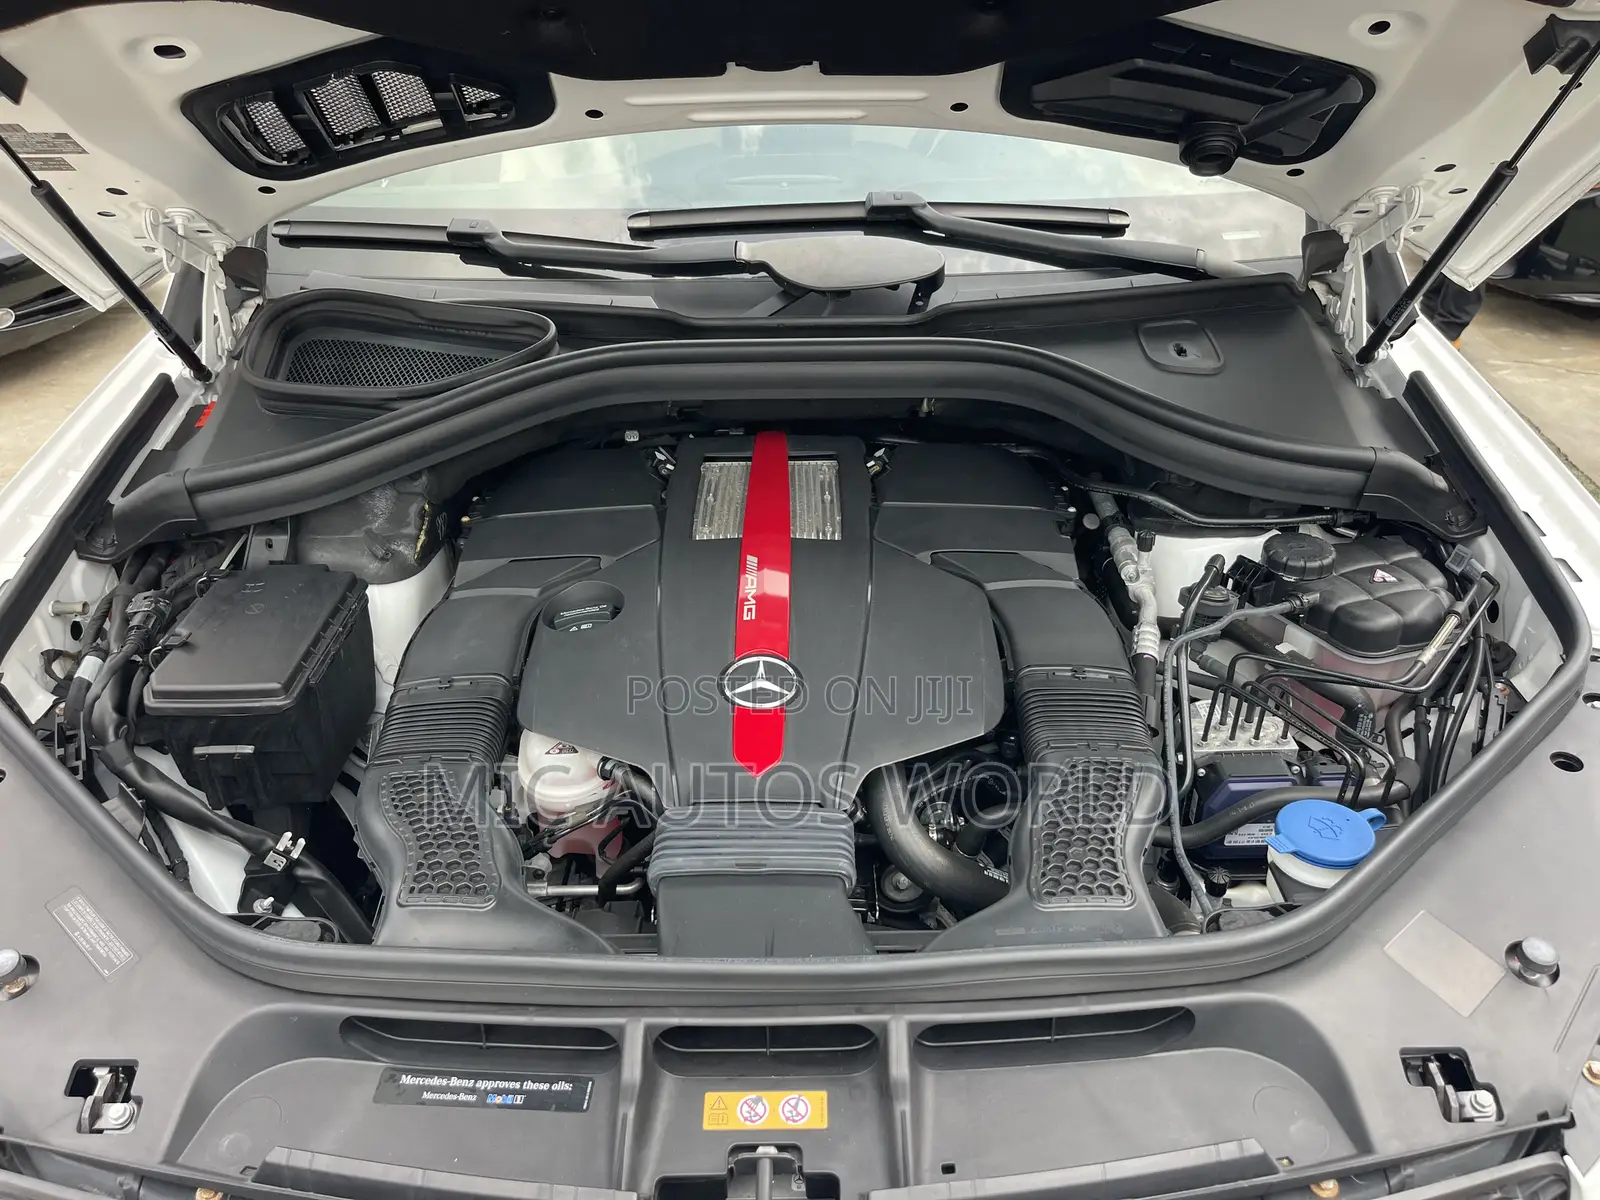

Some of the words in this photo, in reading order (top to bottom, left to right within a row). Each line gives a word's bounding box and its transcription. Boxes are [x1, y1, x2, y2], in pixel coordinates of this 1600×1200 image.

[399, 1075, 474, 1087] Mercedes-Benz
[475, 1079, 520, 1091] approves
[522, 1080, 550, 1091] these
[551, 1080, 573, 1091] oils:
[421, 1091, 477, 1101] Mercedes-Benz
